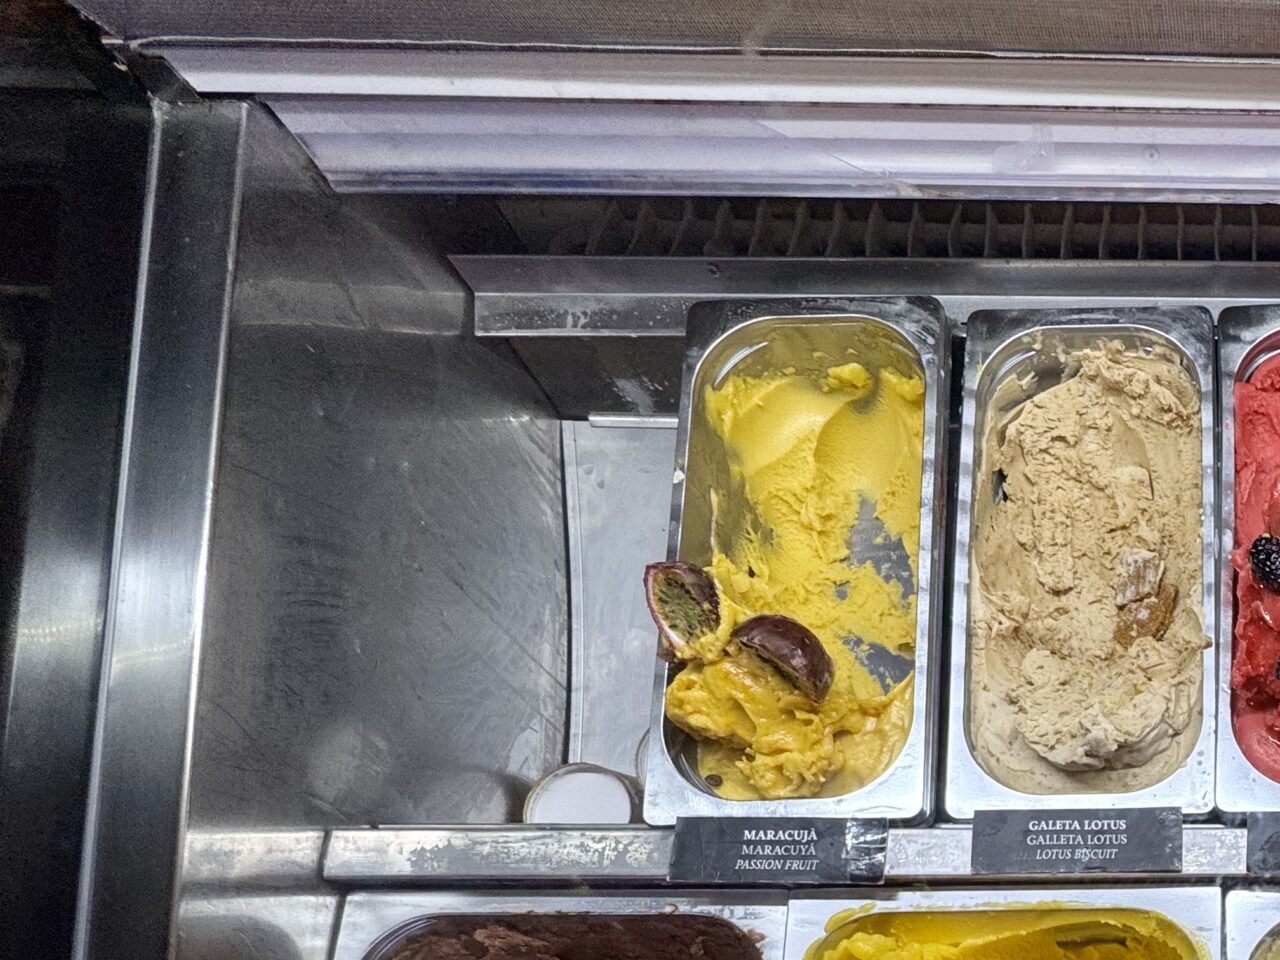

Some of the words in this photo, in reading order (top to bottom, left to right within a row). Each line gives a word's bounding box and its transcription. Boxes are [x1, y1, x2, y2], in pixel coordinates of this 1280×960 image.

[1028, 820, 1081, 831] GALETA
[1083, 819, 1127, 831] LOTUS
[743, 828, 818, 843] MARACUJÀ
[1026, 834, 1085, 846] GALLETA
[1087, 834, 1128, 845] LOTUS
[741, 843, 817, 856] MARACUYÁ
[1035, 848, 1072, 860] LOTUS
[1074, 848, 1119, 860] BISCUIT
[735, 859, 783, 870] PASSION
[784, 859, 820, 871] FRUIT
